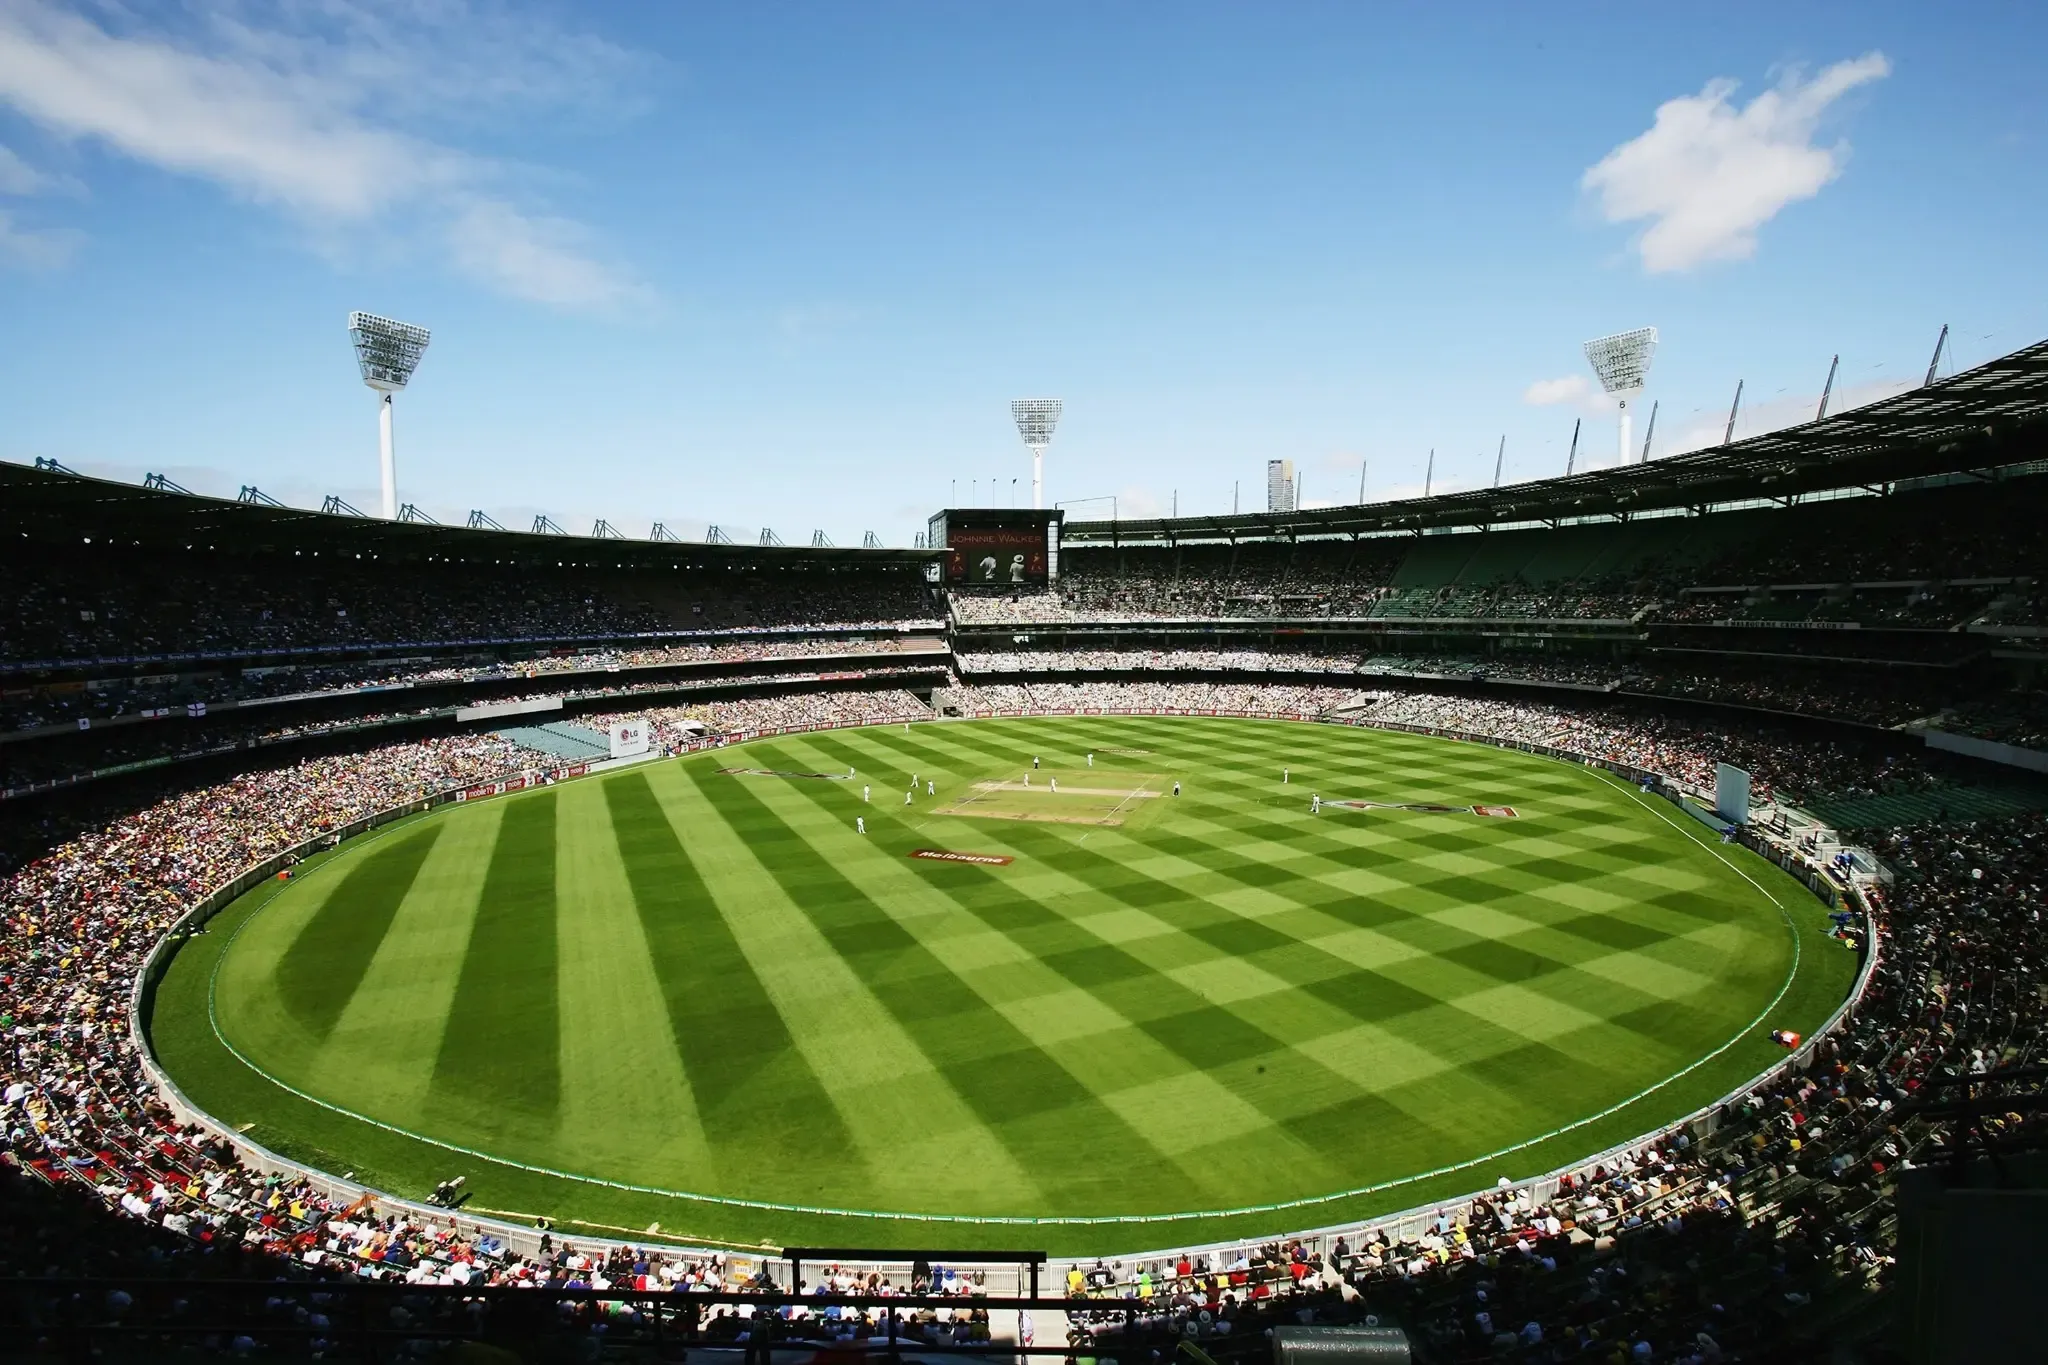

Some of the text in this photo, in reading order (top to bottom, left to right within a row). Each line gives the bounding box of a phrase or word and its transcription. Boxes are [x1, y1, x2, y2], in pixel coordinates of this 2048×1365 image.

[384, 394, 392, 405] 4
[1619, 400, 1626, 409] 6
[950, 533, 1042, 543] JOHNNIE WALKER
[629, 730, 639, 738] LG
[918, 851, 1004, 863] Melbourne
